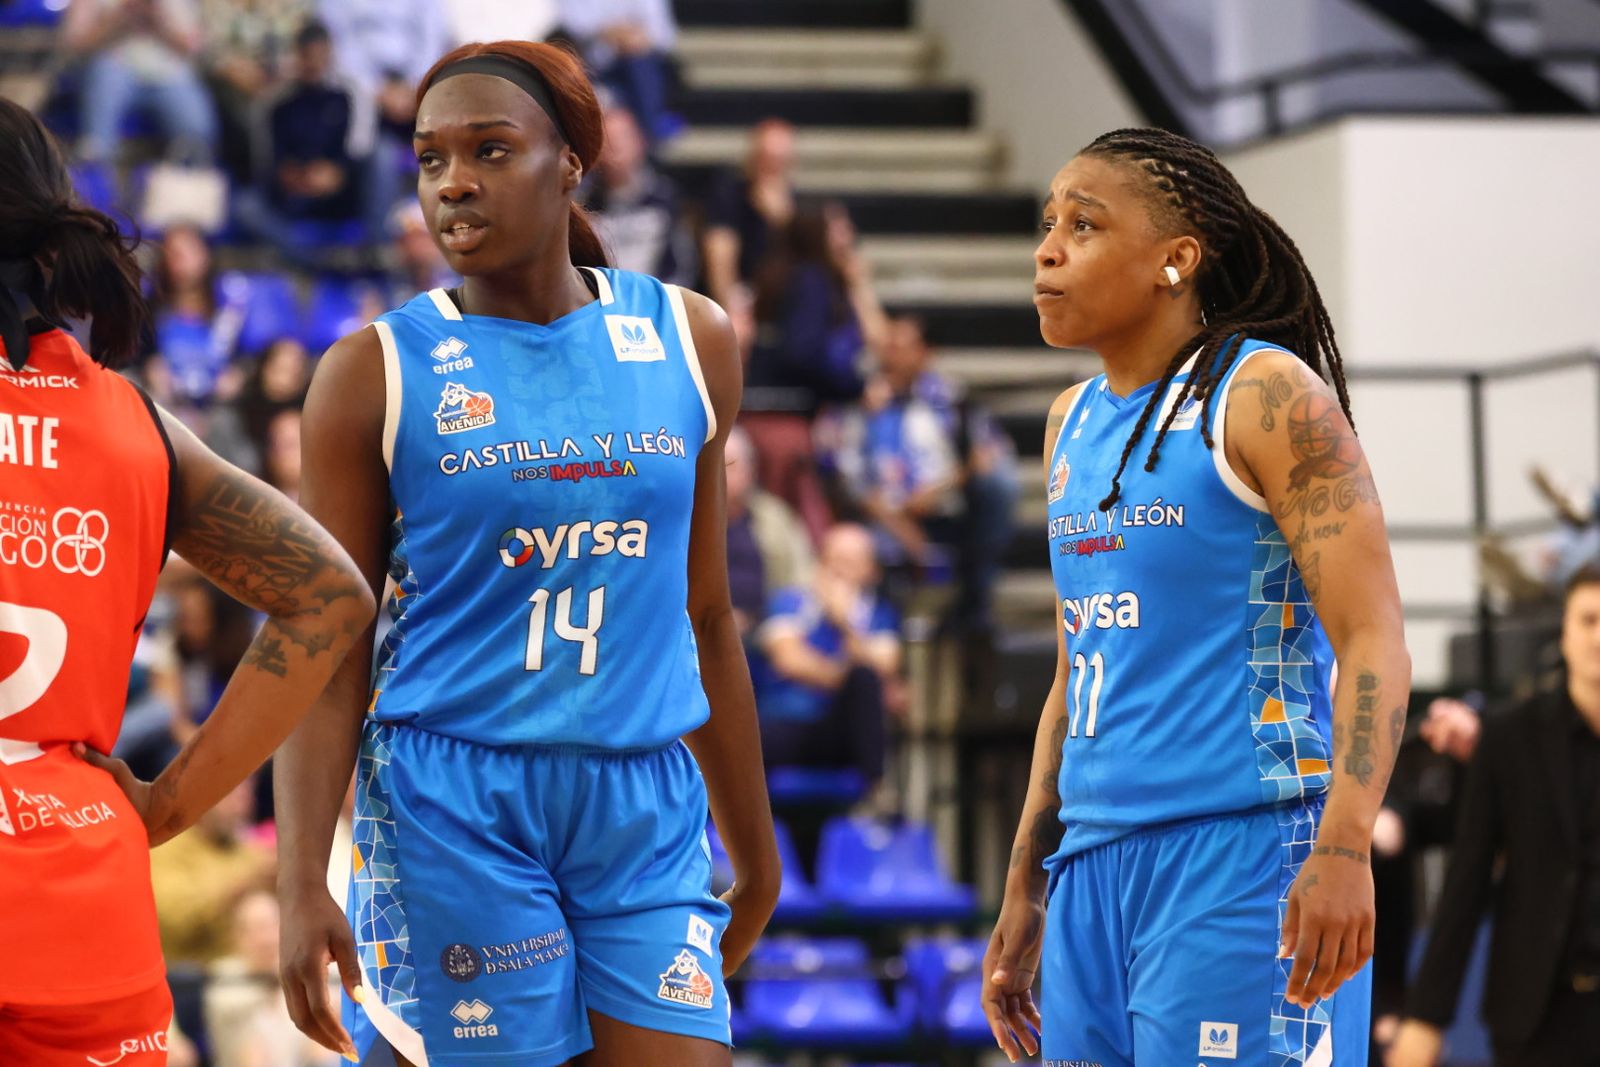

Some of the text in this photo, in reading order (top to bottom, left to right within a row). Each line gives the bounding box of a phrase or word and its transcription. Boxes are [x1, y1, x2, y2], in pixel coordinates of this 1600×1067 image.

[432, 356, 474, 375] errea
[0, 374, 80, 390] RMICK
[440, 412, 492, 433] AVENIDA
[439, 426, 687, 476] CASTILLA Y LEÓN
[512, 459, 637, 484] NOS IMPULSA
[0, 501, 47, 515] ENCIA
[1106, 507, 1118, 534] Y
[1122, 497, 1185, 528] LEÓN
[0, 531, 48, 569] GO
[499, 518, 650, 569] oyrsa
[1063, 590, 1141, 640] oyrsa
[523, 583, 607, 677] 14
[1070, 651, 1105, 739] 11
[18, 806, 55, 832] DE
[660, 985, 711, 1007] AVENIDA
[453, 1024, 499, 1039] errea
